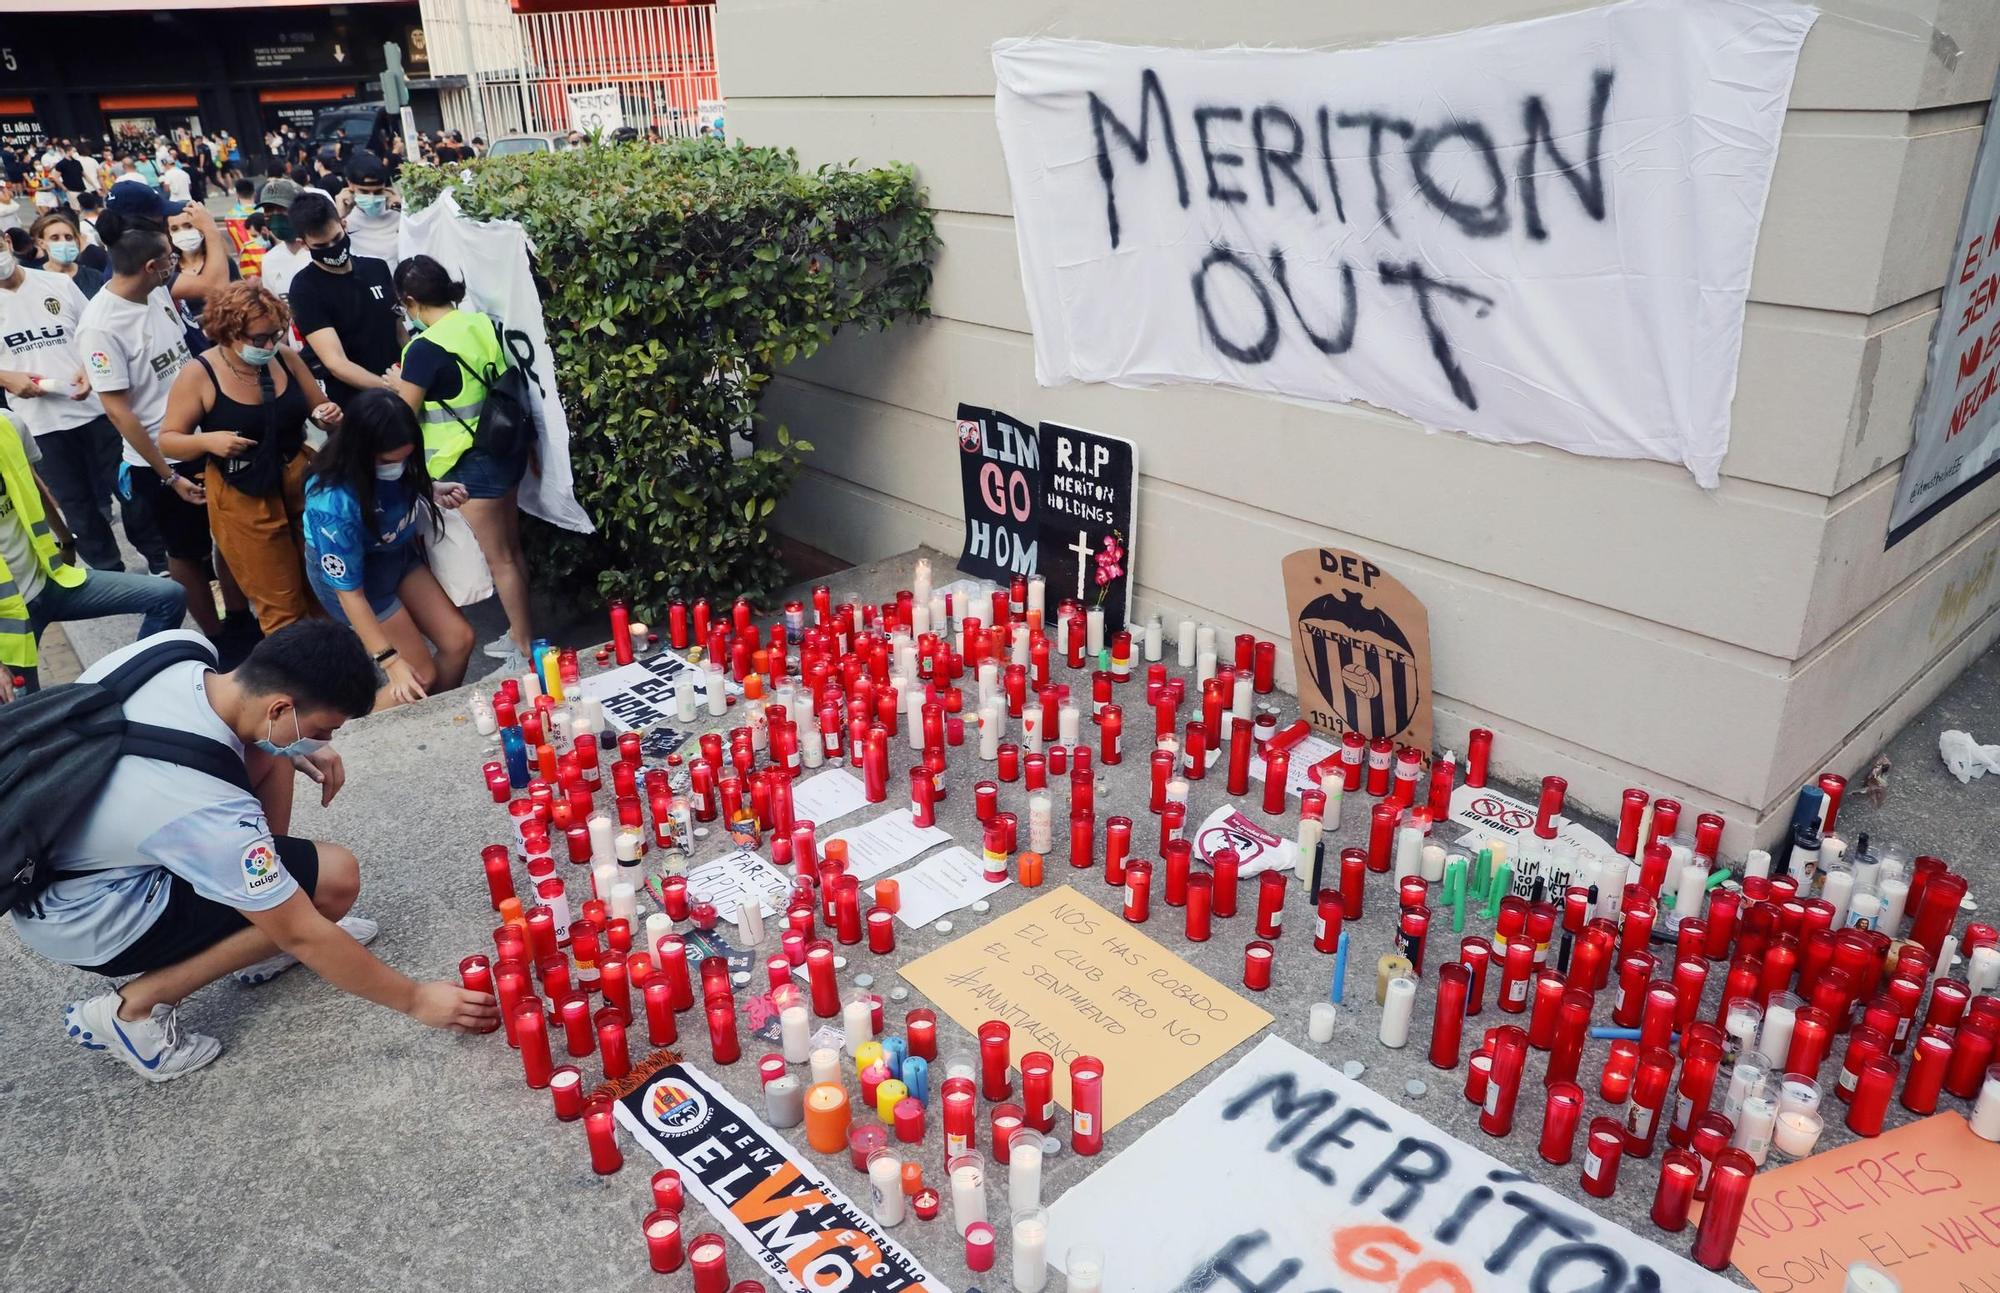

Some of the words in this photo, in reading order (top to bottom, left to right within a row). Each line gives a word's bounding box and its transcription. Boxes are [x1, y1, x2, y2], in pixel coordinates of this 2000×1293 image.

[2, 48, 17, 71] 5
[1087, 67, 1616, 250] MERITON
[1191, 240, 1496, 411] OUT
[979, 419, 1040, 471] LIM
[979, 462, 1032, 523] GO
[1047, 493, 1114, 525] HOLDINGS
[1053, 474, 1115, 504] MERiTON
[969, 518, 1039, 577] HOM
[600, 692, 669, 730] HOME
[629, 677, 677, 705] GO
[1310, 710, 1344, 734] 1919
[249, 871, 279, 889] LaLiga
[729, 852, 787, 894] PAREJO
[1517, 875, 1532, 885] GO
[983, 941, 1011, 965] EL
[1021, 964, 1127, 1036] SENTIMIENTO
[1013, 923, 1048, 948] EL
[1053, 948, 1105, 983] CLUB
[1110, 986, 1158, 1020] PERO
[1161, 1018, 1202, 1047] NO
[1049, 902, 1101, 936] NOS
[1101, 936, 1148, 967] HAS
[1146, 967, 1230, 1023] ROBADO
[944, 966, 1081, 1066] #AMUNTVALENC
[677, 1135, 753, 1205] EL
[720, 1122, 786, 1177] PEÑA
[756, 1248, 789, 1275] 1992
[791, 1184, 905, 1290] VALENCI
[836, 1202, 926, 1283] ANIVERSARIO
[1857, 1231, 1929, 1267] EL
[1756, 1247, 1848, 1293] SOM
